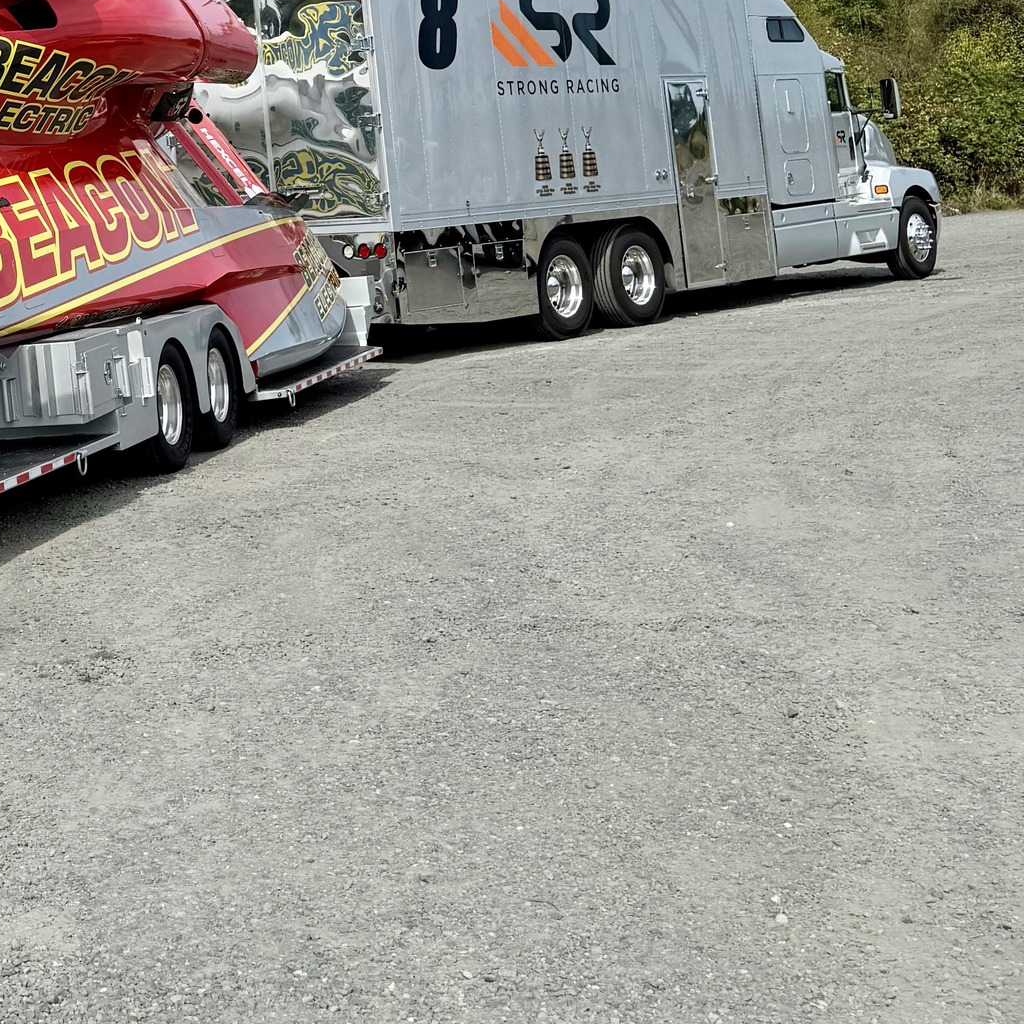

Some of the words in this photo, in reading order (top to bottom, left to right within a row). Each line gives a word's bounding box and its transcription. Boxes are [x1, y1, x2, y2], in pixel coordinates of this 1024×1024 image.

[497, 79, 559, 96] STRONG
[566, 78, 620, 94] RACING
[199, 127, 253, 187] HEXCEL
